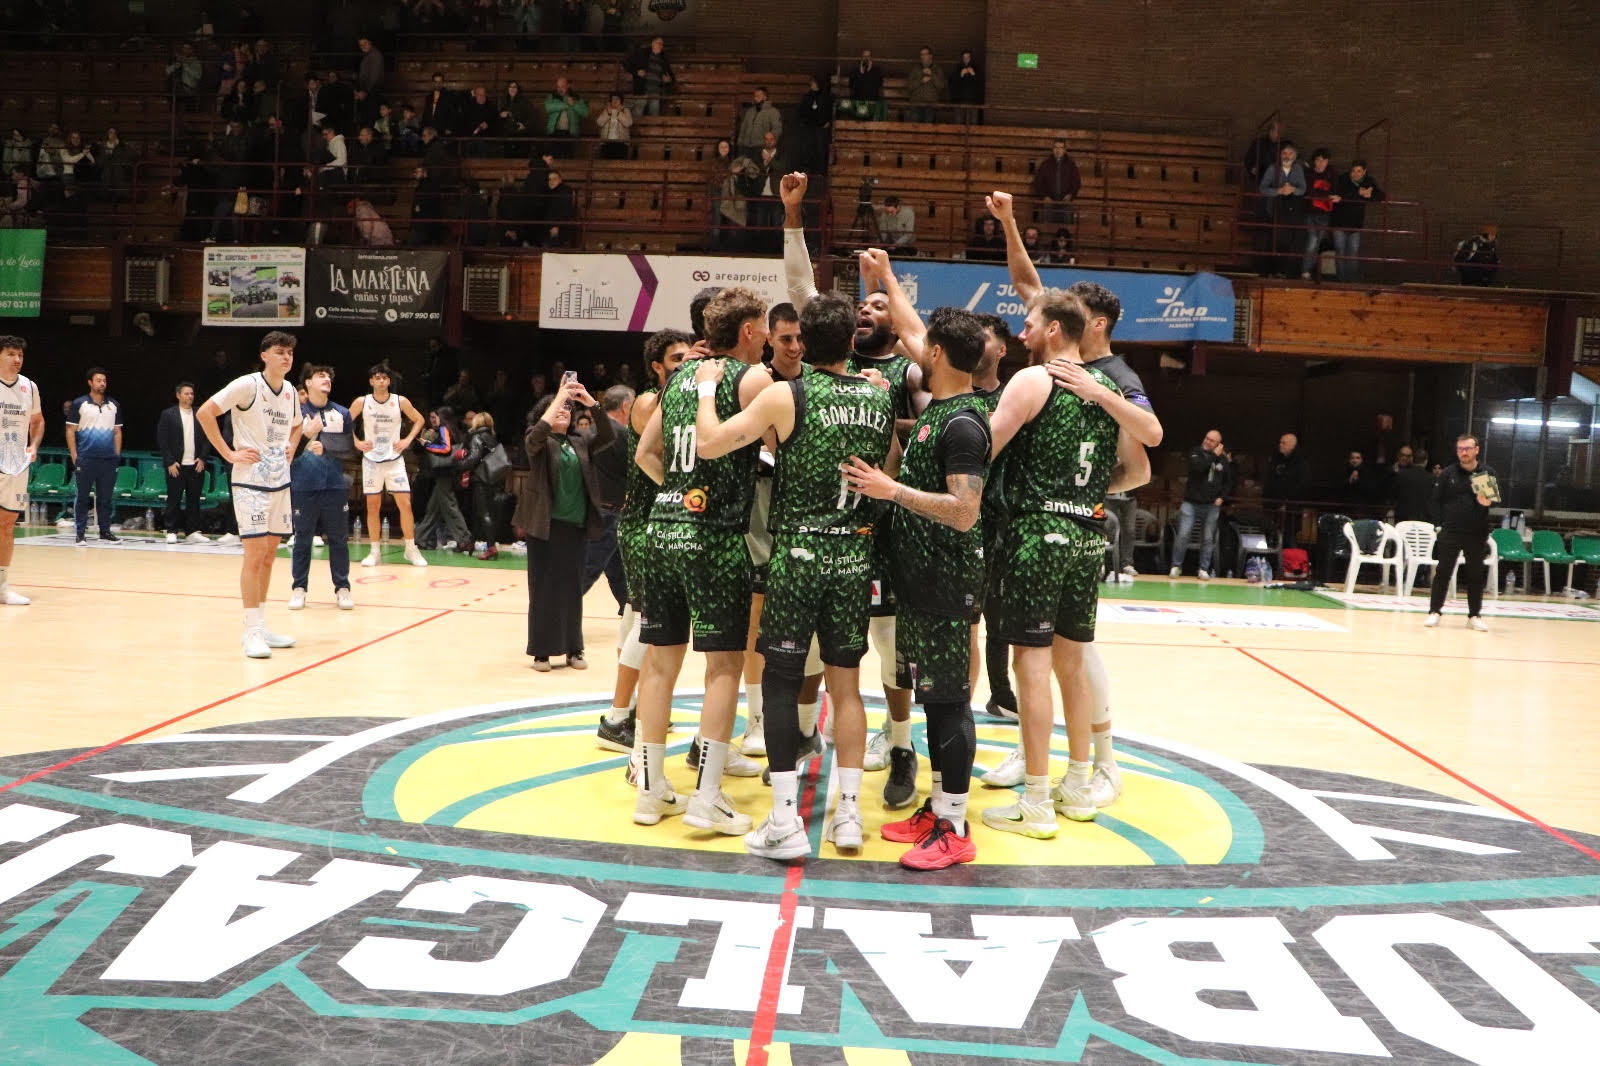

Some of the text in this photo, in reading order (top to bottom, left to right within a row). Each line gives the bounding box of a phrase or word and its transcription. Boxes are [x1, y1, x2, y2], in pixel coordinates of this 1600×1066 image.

[329, 263, 431, 295] LA MARTEÑA
[715, 272, 778, 283] areaproject
[353, 291, 414, 305] cañas y tapas
[996, 302, 1028, 315] CON
[819, 402, 887, 434] GONZÁLEZ
[669, 425, 697, 473] 10
[1074, 441, 1096, 487] 5
[1044, 500, 1093, 518] amiab
[668, 542, 703, 550] MANCHA
[820, 567, 832, 575] LA
